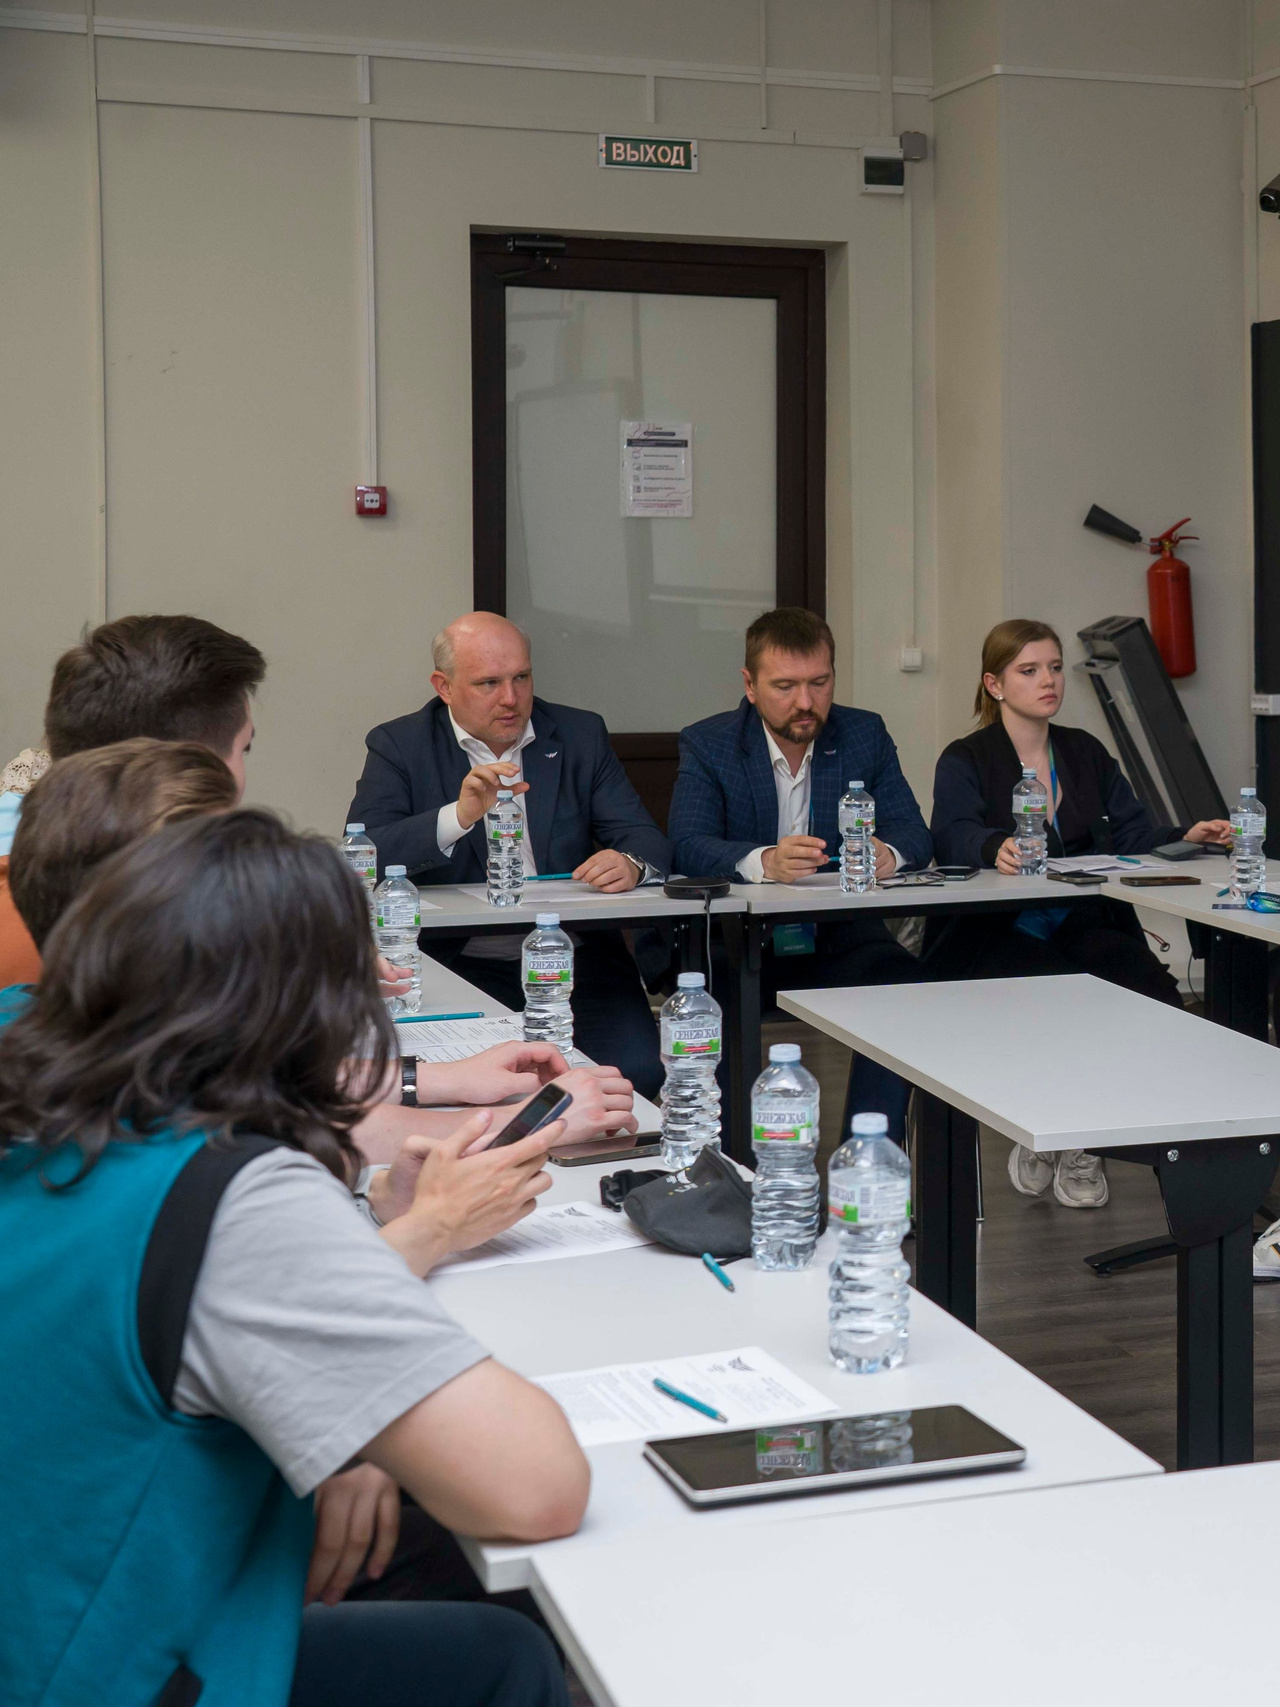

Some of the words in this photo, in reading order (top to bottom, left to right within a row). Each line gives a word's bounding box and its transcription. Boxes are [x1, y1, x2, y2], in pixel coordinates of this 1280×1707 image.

[612, 142, 685, 166] ВЫХОД
[528, 960, 569, 970] СЕНЕЖСКАЯ
[674, 1027, 719, 1040] СЕНЕЖСКАЯ
